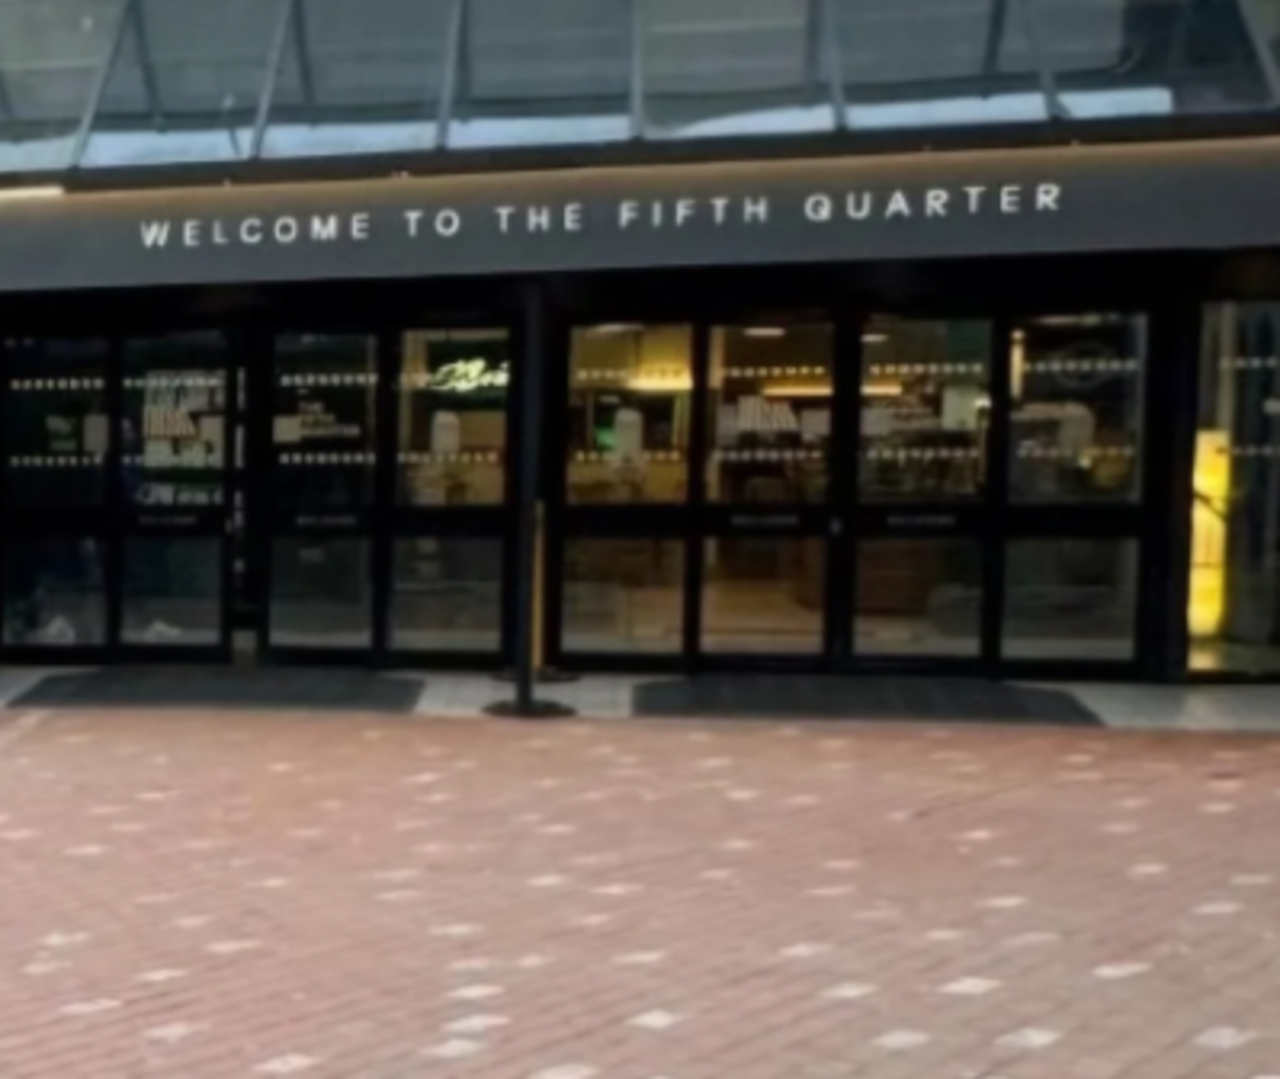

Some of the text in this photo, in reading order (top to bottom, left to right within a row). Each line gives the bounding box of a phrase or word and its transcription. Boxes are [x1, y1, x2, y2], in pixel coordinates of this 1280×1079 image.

[140, 183, 1061, 248] WELCOME TO THE FIFTH QUARTER
